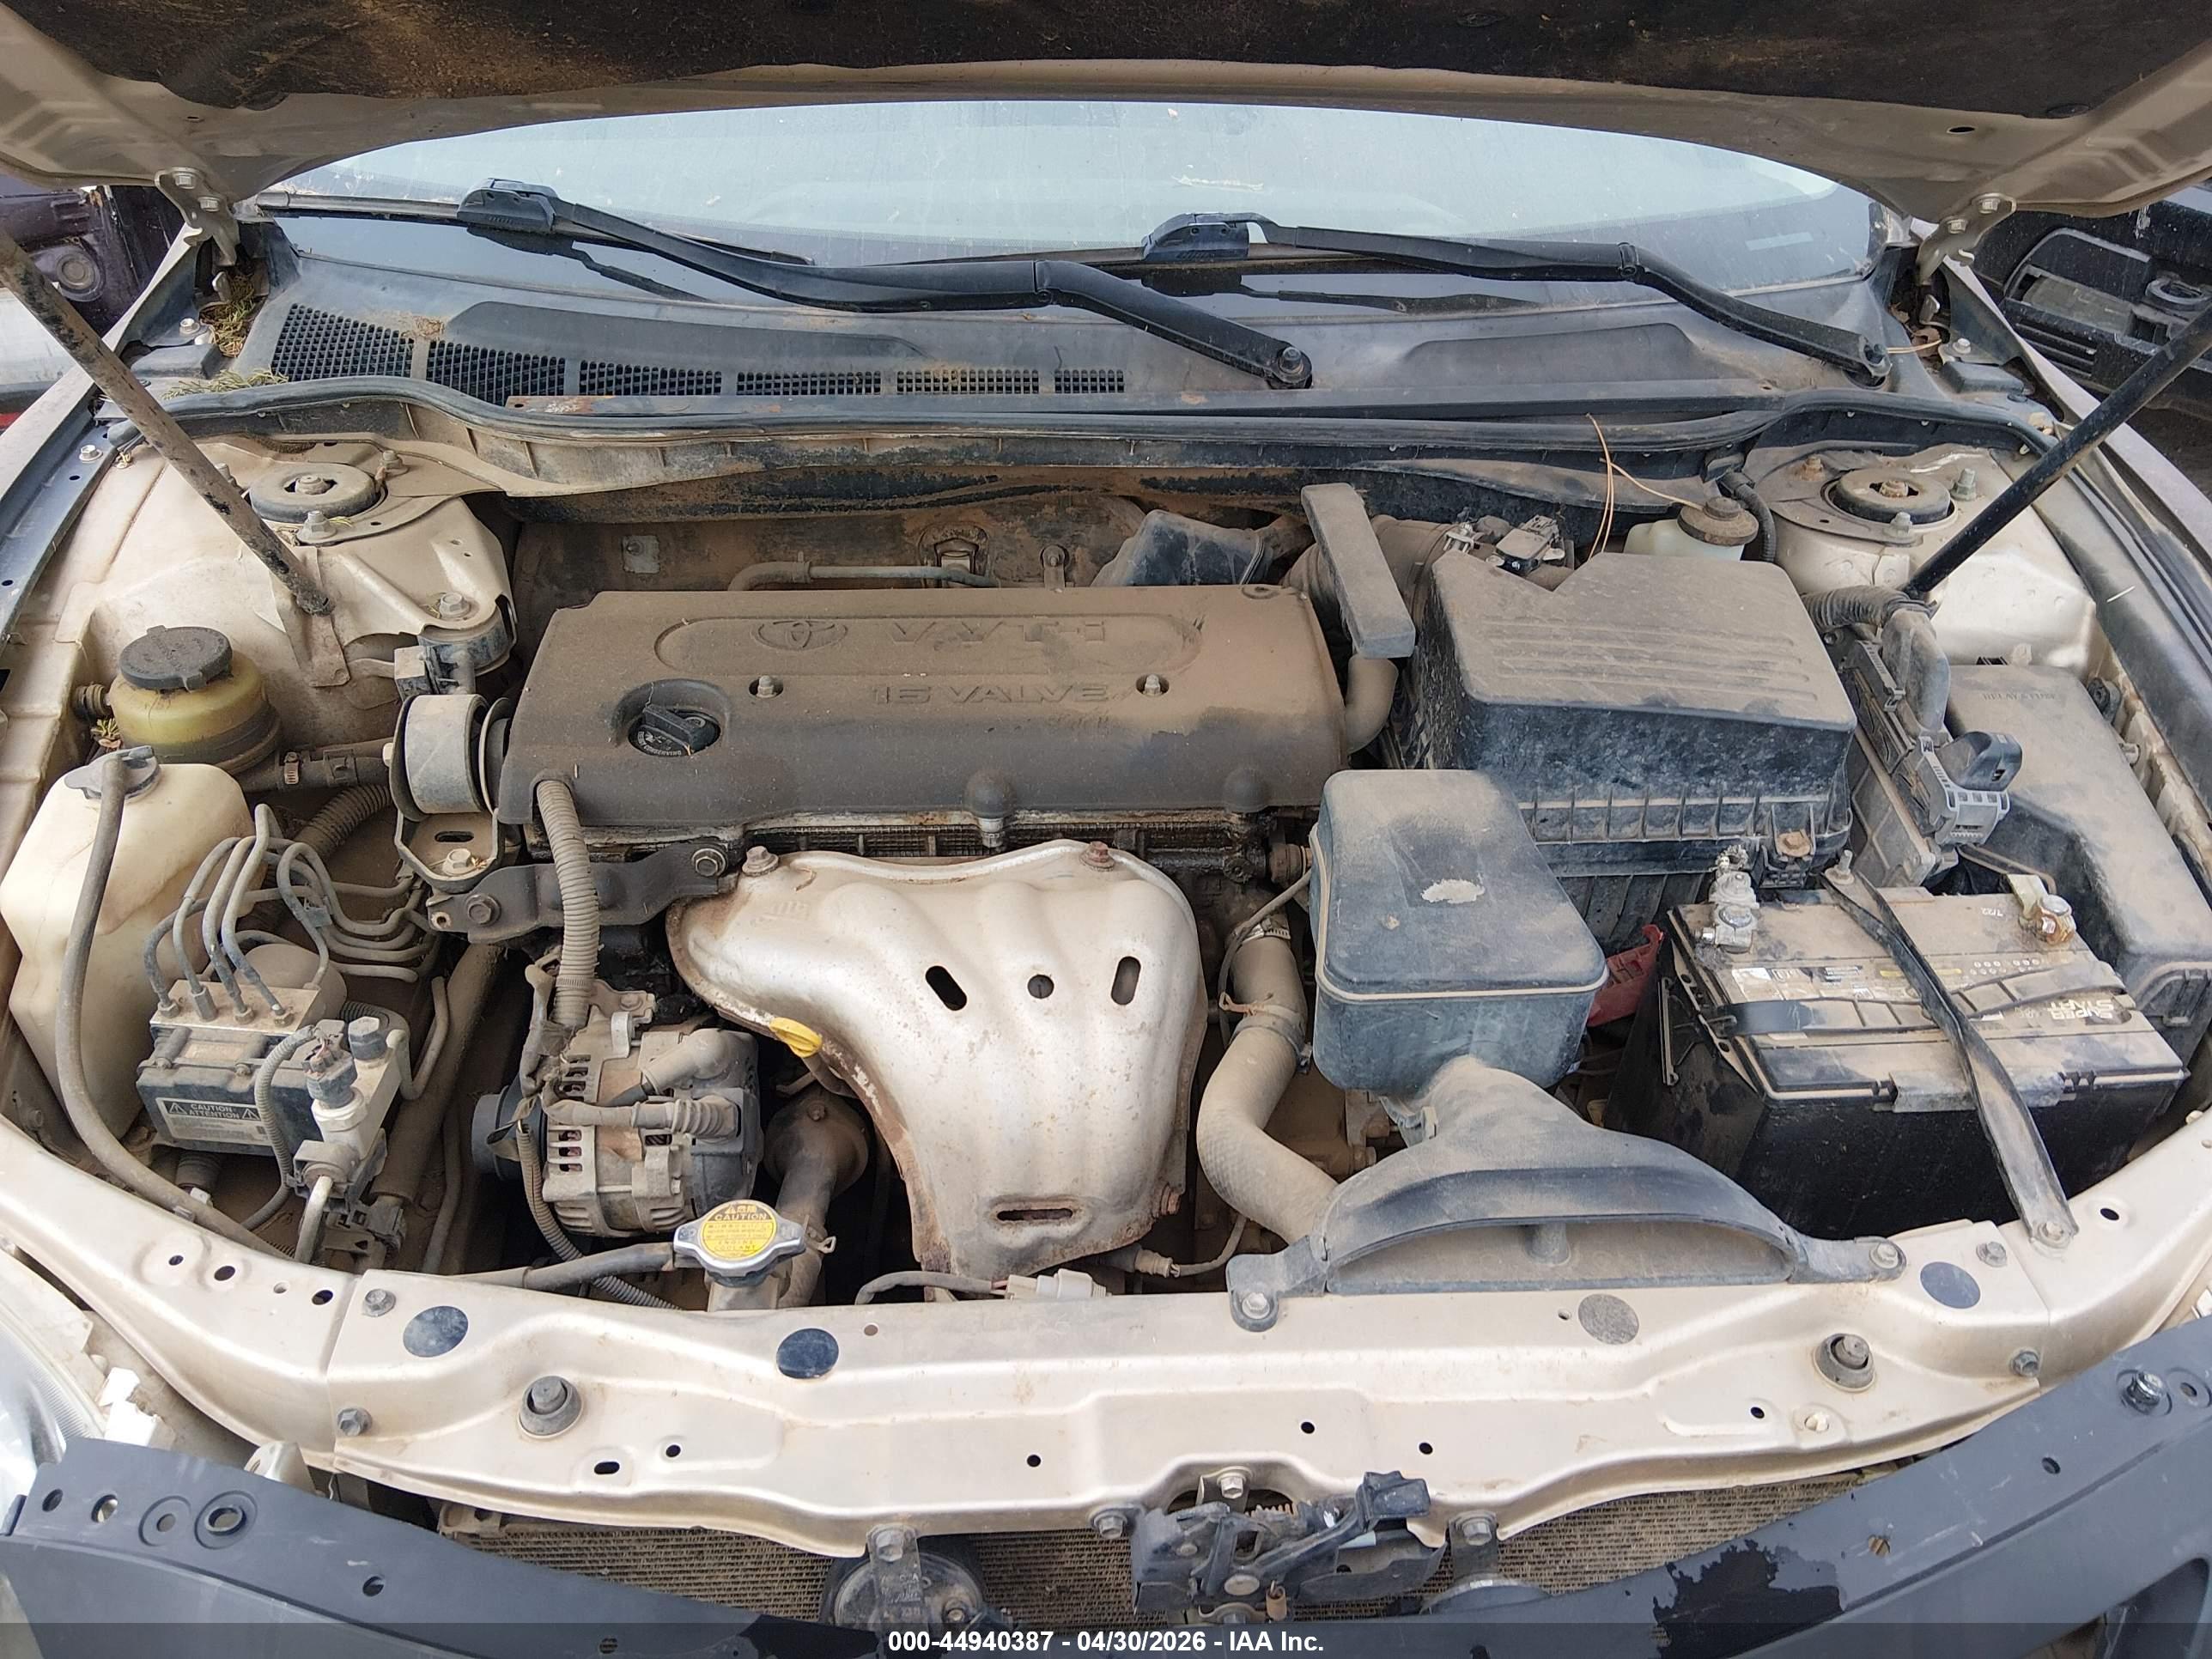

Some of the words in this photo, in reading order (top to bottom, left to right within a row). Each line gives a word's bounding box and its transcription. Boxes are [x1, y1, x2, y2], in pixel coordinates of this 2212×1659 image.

[946, 684, 1109, 704] VALVE
[190, 1103, 234, 1114] CAUTION
[188, 1109, 240, 1120] ATTENTION
